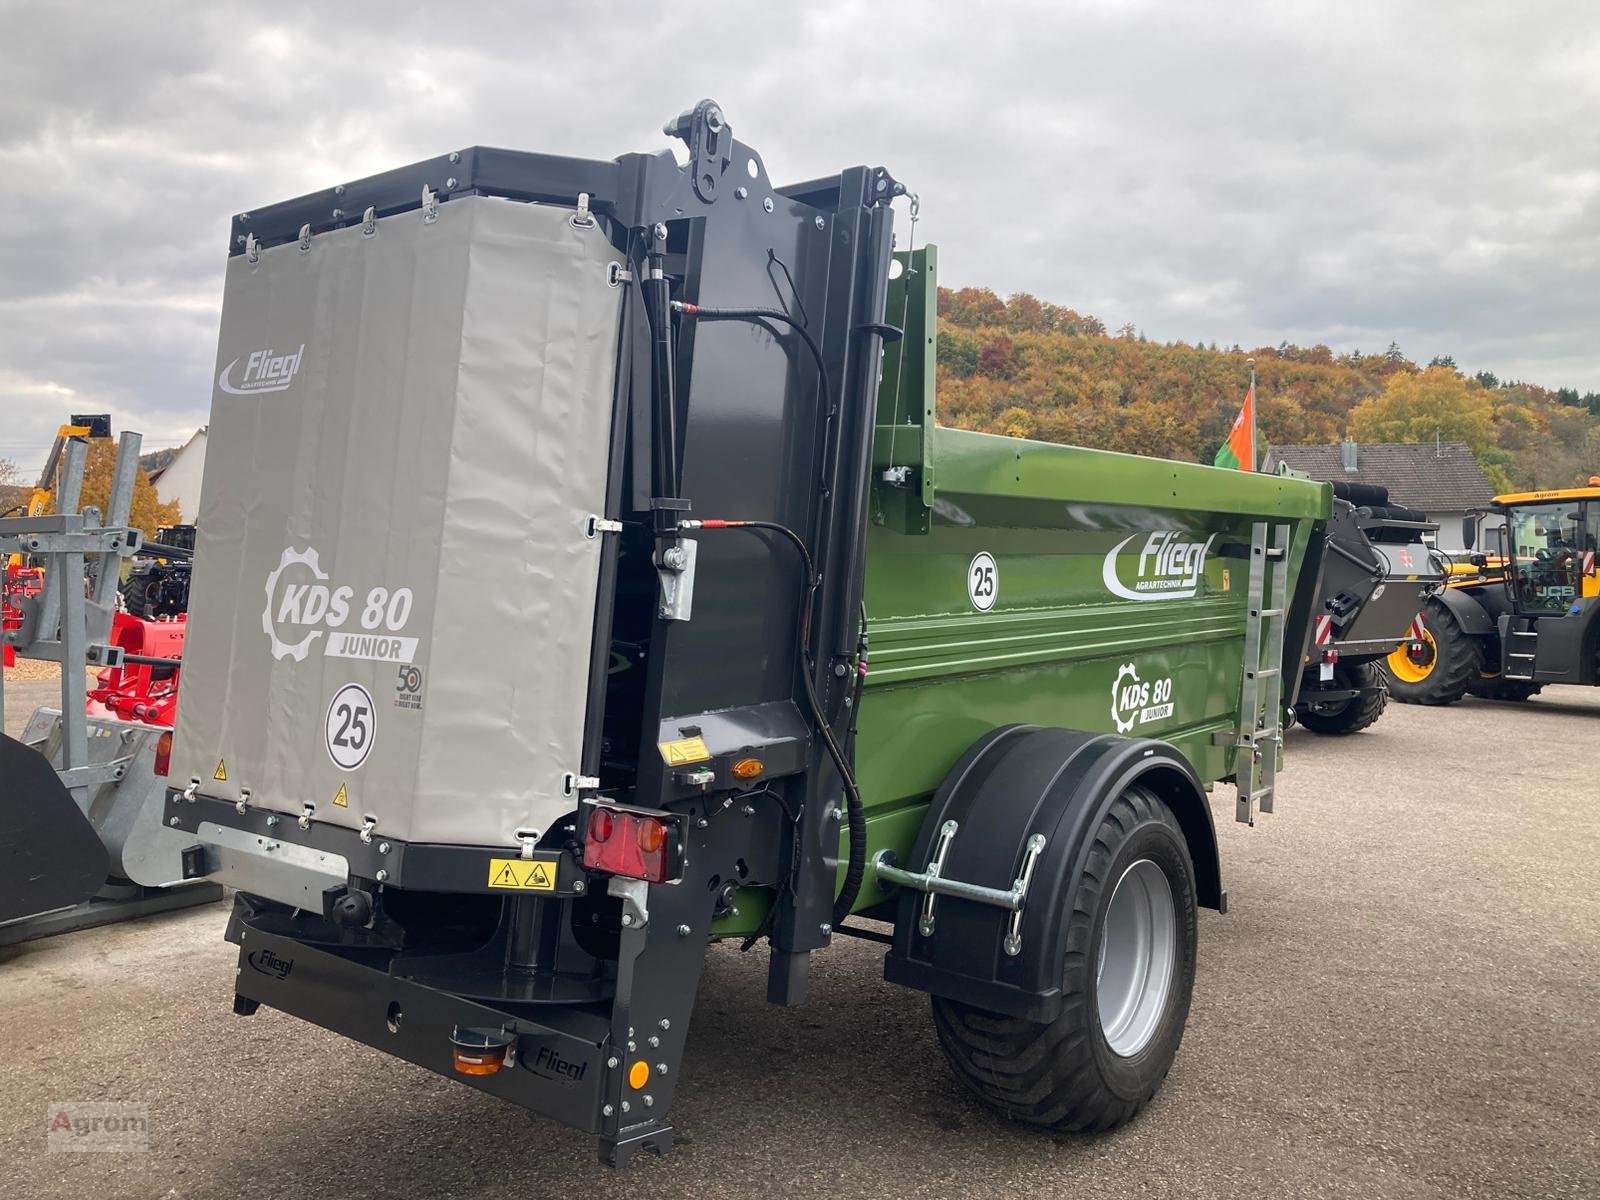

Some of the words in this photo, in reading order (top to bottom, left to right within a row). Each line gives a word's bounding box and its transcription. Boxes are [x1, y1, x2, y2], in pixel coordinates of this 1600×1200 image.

[243, 344, 305, 384] Fliegl
[1138, 530, 1219, 588] Fliegl
[974, 566, 993, 597] 25
[1135, 580, 1182, 591] AGRARTECHNIK
[1536, 585, 1575, 597] JCB
[277, 584, 354, 627] KDS
[361, 587, 413, 631] 80
[340, 636, 402, 659] JUNIOR
[1120, 682, 1150, 712] KDS
[1153, 678, 1172, 704] 80
[332, 703, 368, 750] 25
[1145, 705, 1169, 720] JUNIOR
[260, 949, 294, 977] Fliegl
[536, 1046, 588, 1081] Fliegl
